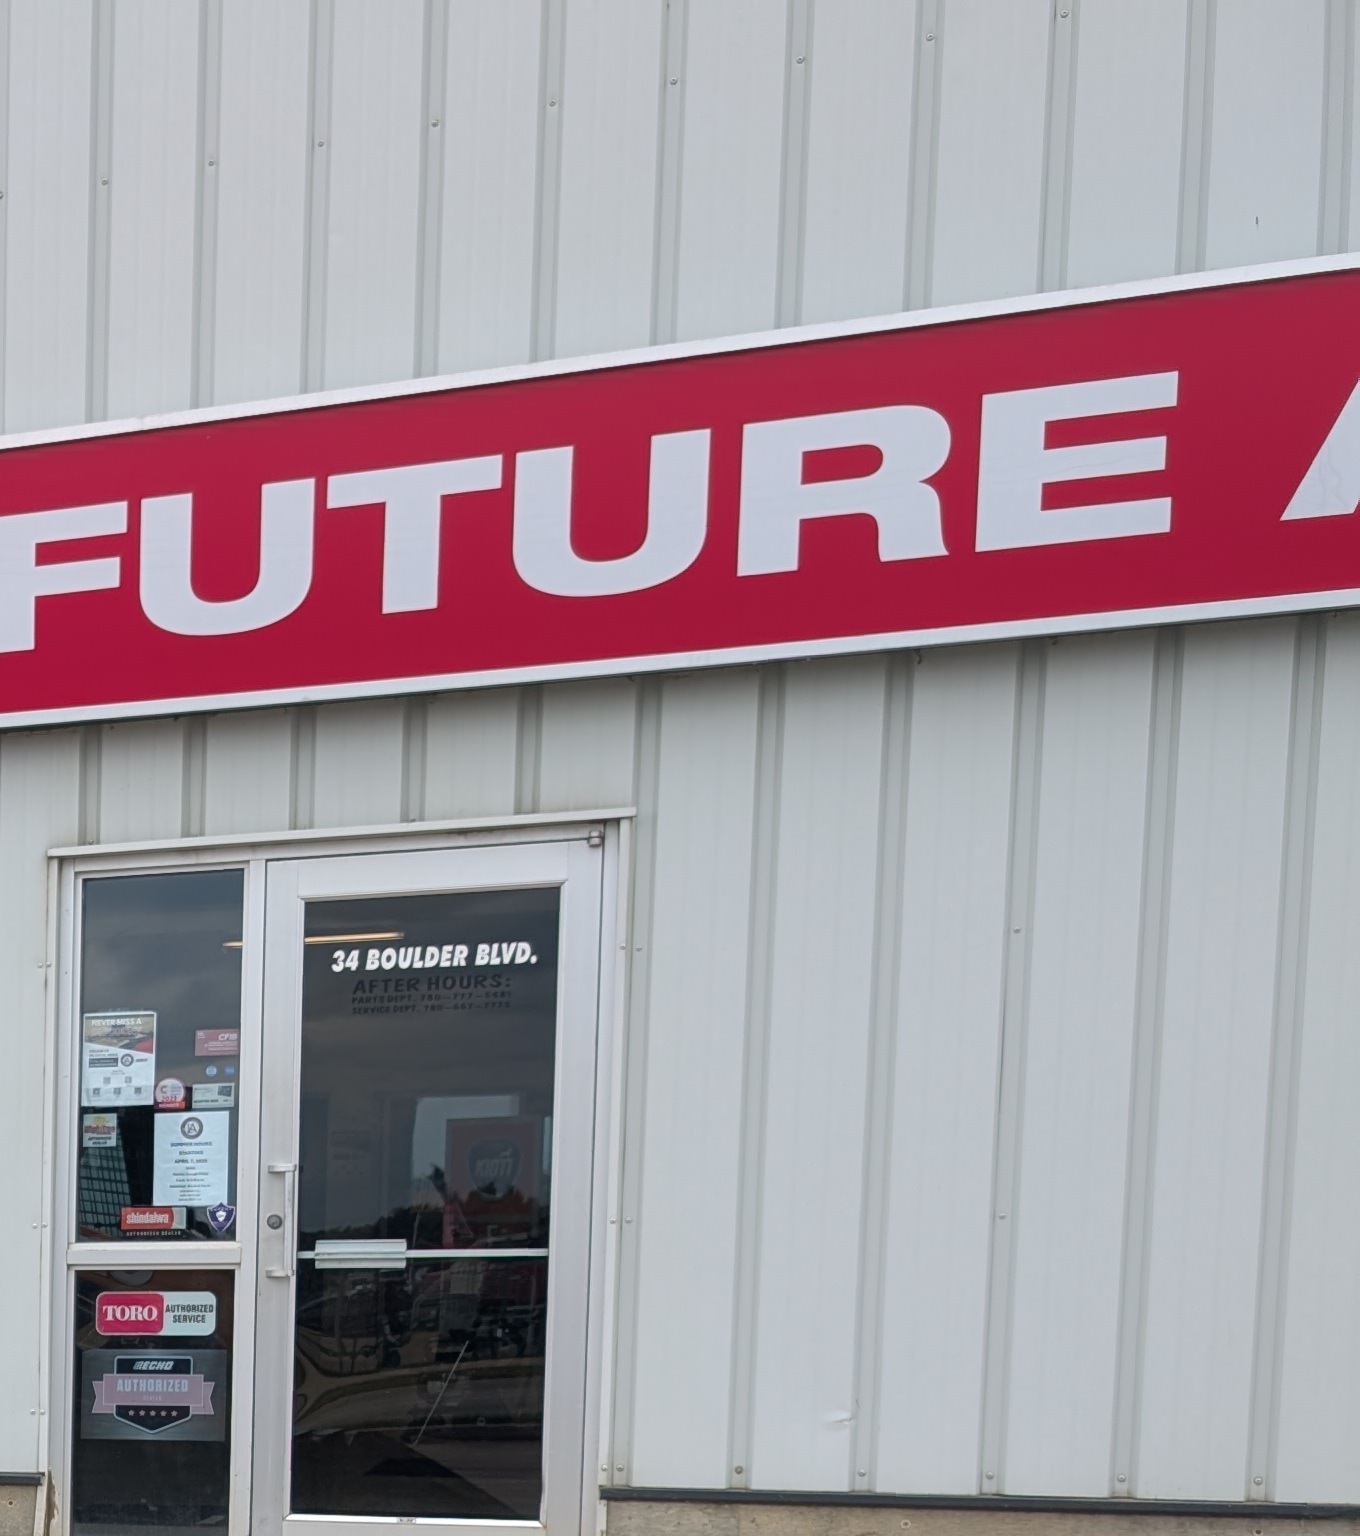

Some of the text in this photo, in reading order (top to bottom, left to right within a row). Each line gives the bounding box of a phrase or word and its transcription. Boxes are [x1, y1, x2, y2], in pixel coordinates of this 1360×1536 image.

[330, 940, 539, 973] 34 BOULDER BLVD.
[352, 973, 511, 995] AFTER HOURS:
[351, 996, 385, 1005] PARTS
[352, 1005, 391, 1015] SERVICE
[102, 1304, 214, 1321] TORO AUTHORIZED
[172, 1314, 206, 1324] SERVICE
[141, 1361, 174, 1370] ECHO
[116, 1379, 189, 1393] AUTHORIZED
